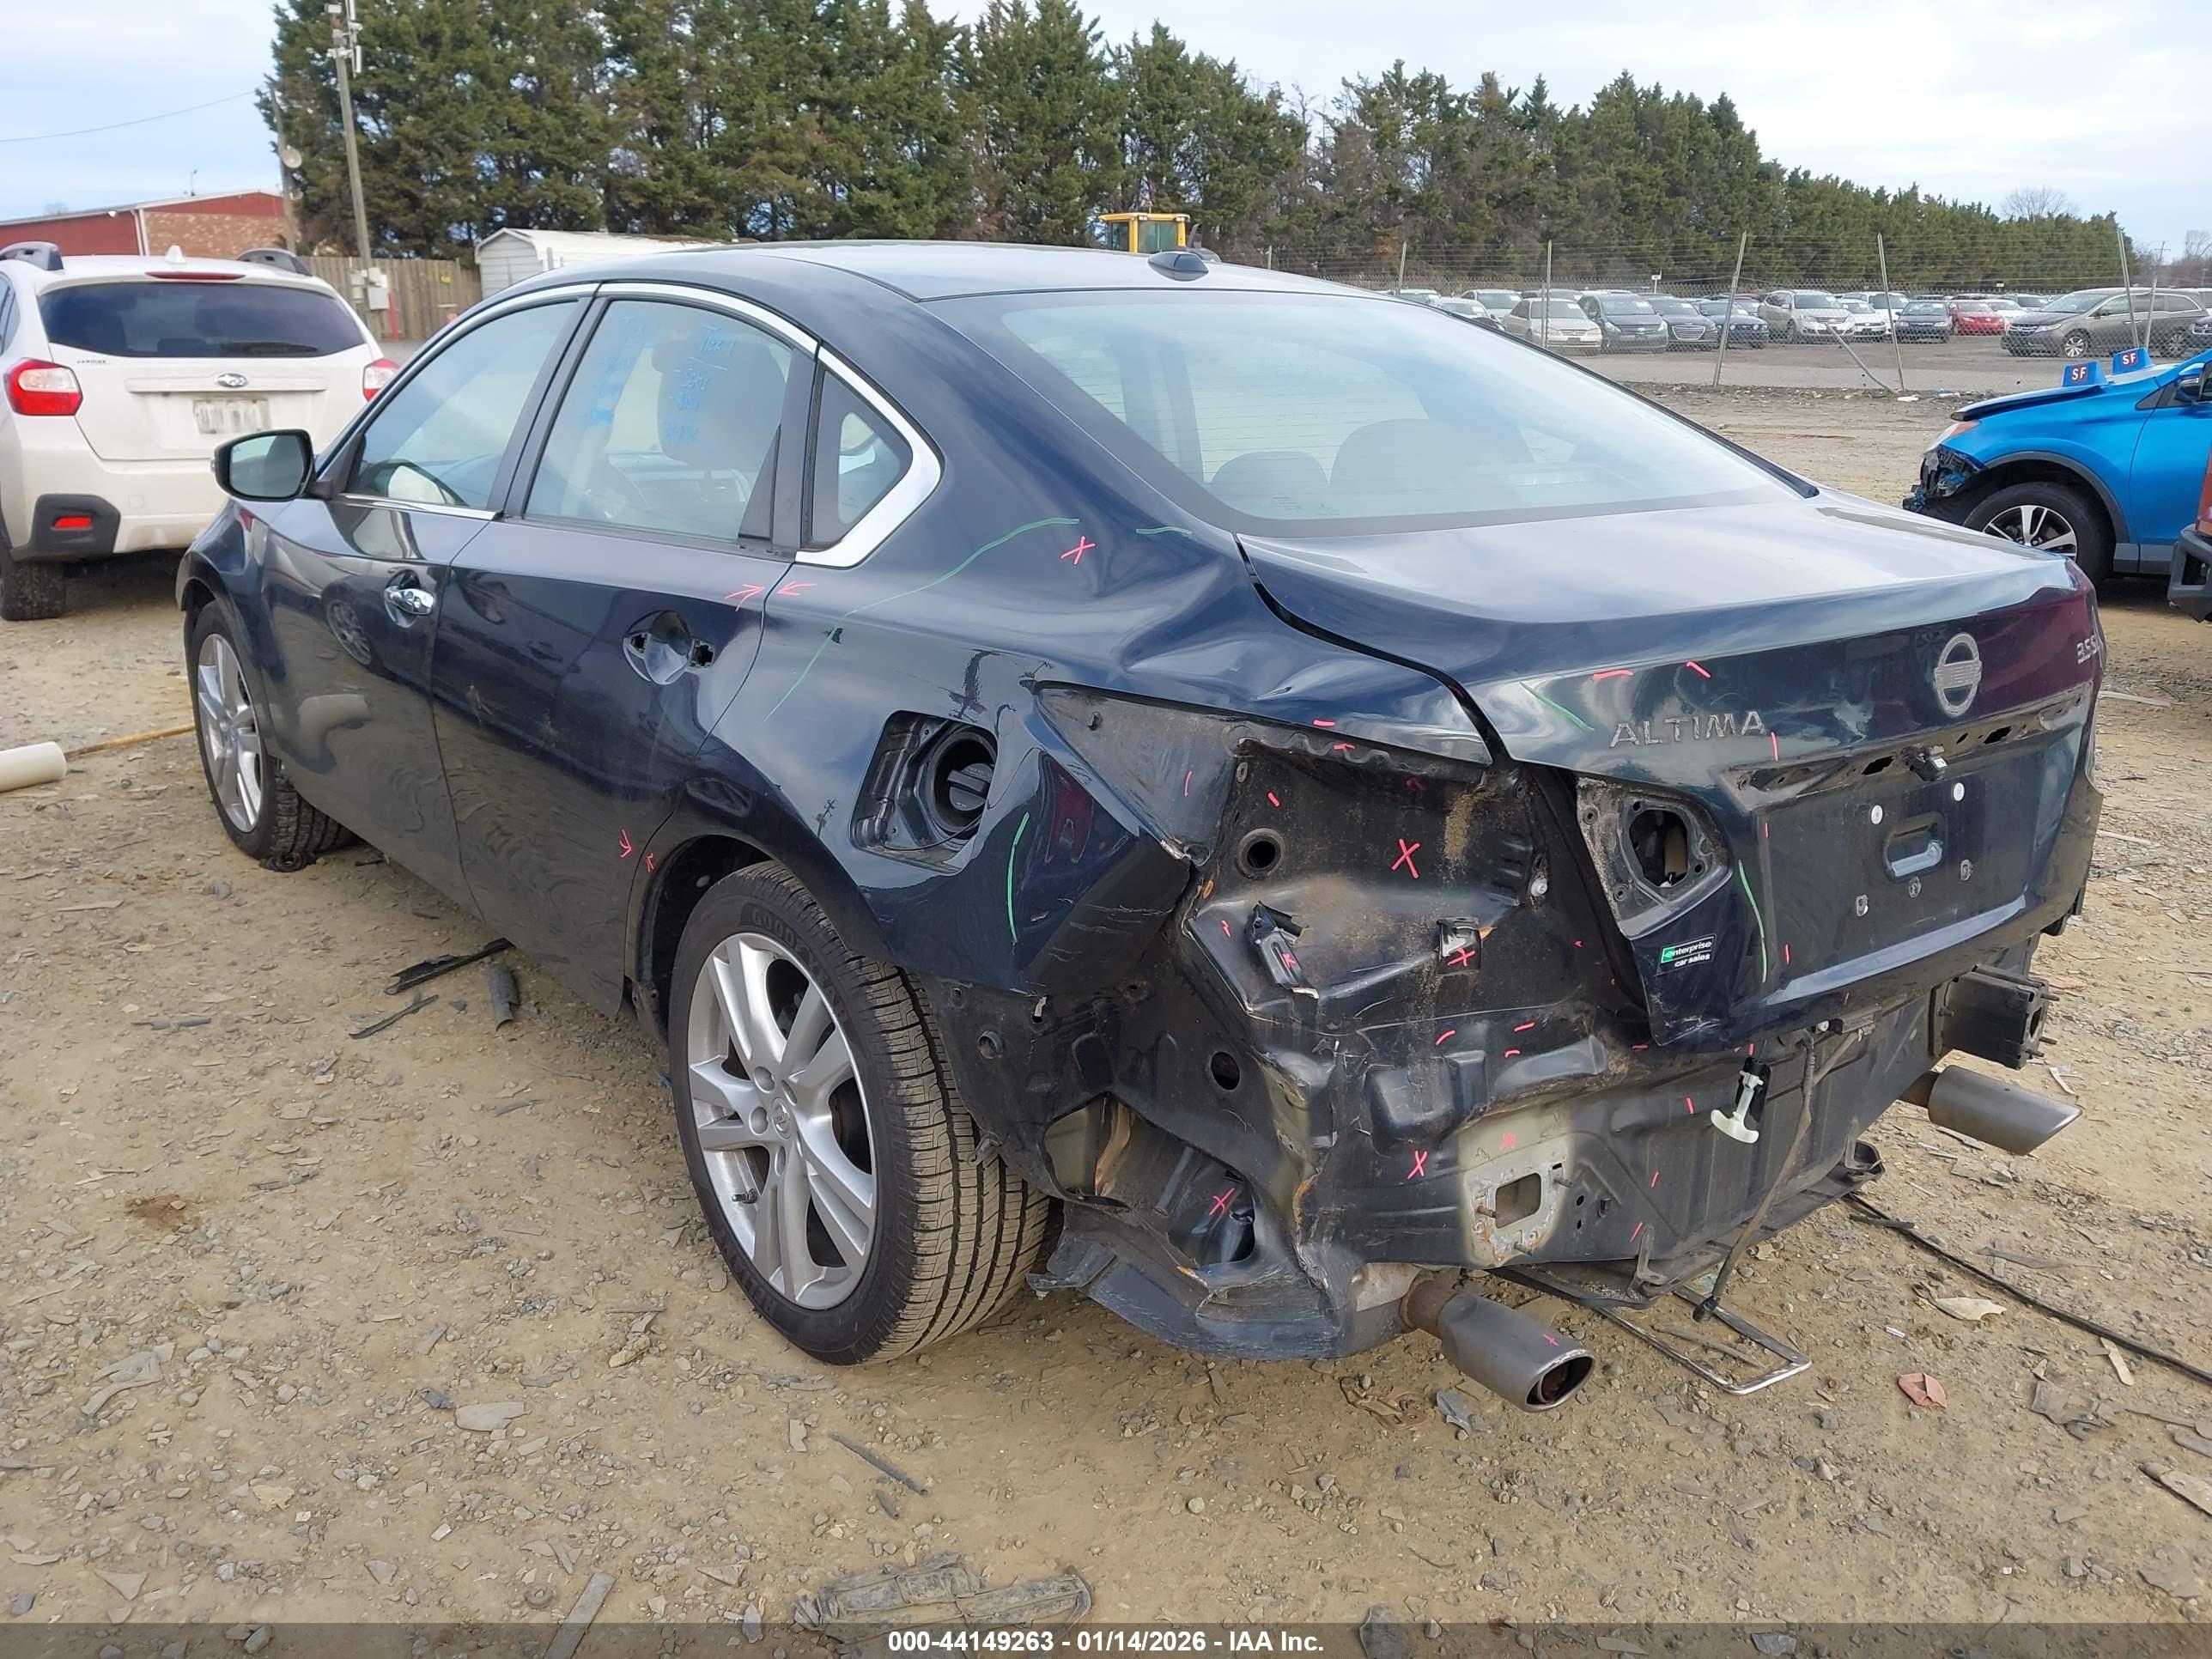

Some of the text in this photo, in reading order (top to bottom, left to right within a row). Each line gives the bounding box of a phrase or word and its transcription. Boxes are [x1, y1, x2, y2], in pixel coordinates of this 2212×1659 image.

[2122, 353, 2136, 365] SF
[2071, 367, 2087, 380] SF
[1609, 710, 1765, 749] ALTIMA
[1662, 941, 1712, 959] enterprise
[1687, 954, 1711, 963] sales
